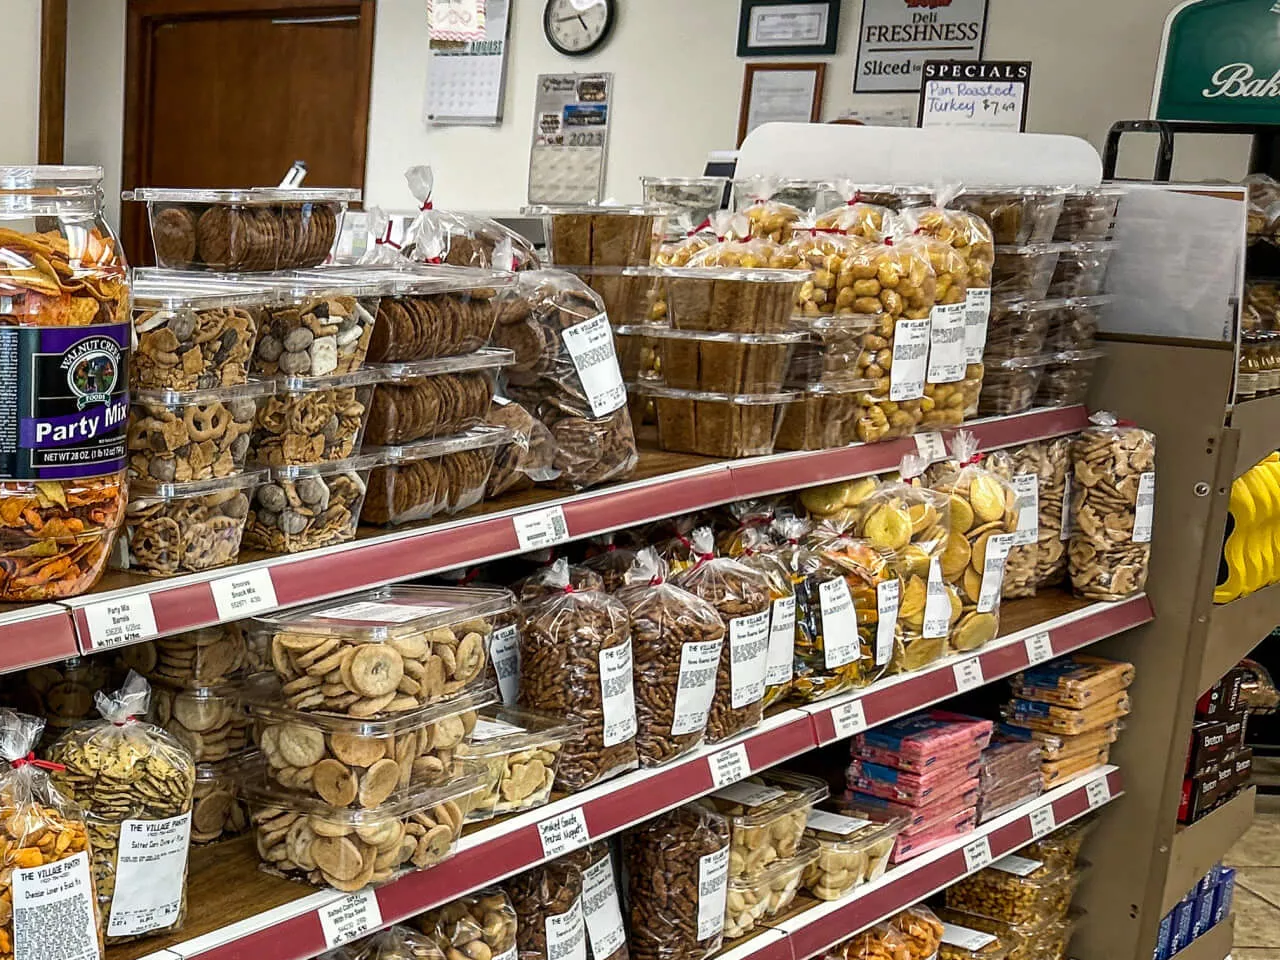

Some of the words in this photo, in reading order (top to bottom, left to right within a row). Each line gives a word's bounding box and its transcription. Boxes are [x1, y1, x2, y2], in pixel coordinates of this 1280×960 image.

[912, 12, 937, 24] Deli
[865, 23, 978, 43] FRESHNESS
[471, 41, 503, 50] AUGUST
[863, 59, 911, 76] Sliced
[926, 65, 1027, 78] SPECIALS
[1202, 62, 1280, 97] Bak
[929, 97, 974, 117] Turkey
[60, 340, 99, 370] WALNUT
[36, 414, 100, 443] Party
[105, 403, 127, 428] Mix
[146, 820, 169, 831] VILLAGE
[37, 864, 62, 879] VILLAGE
